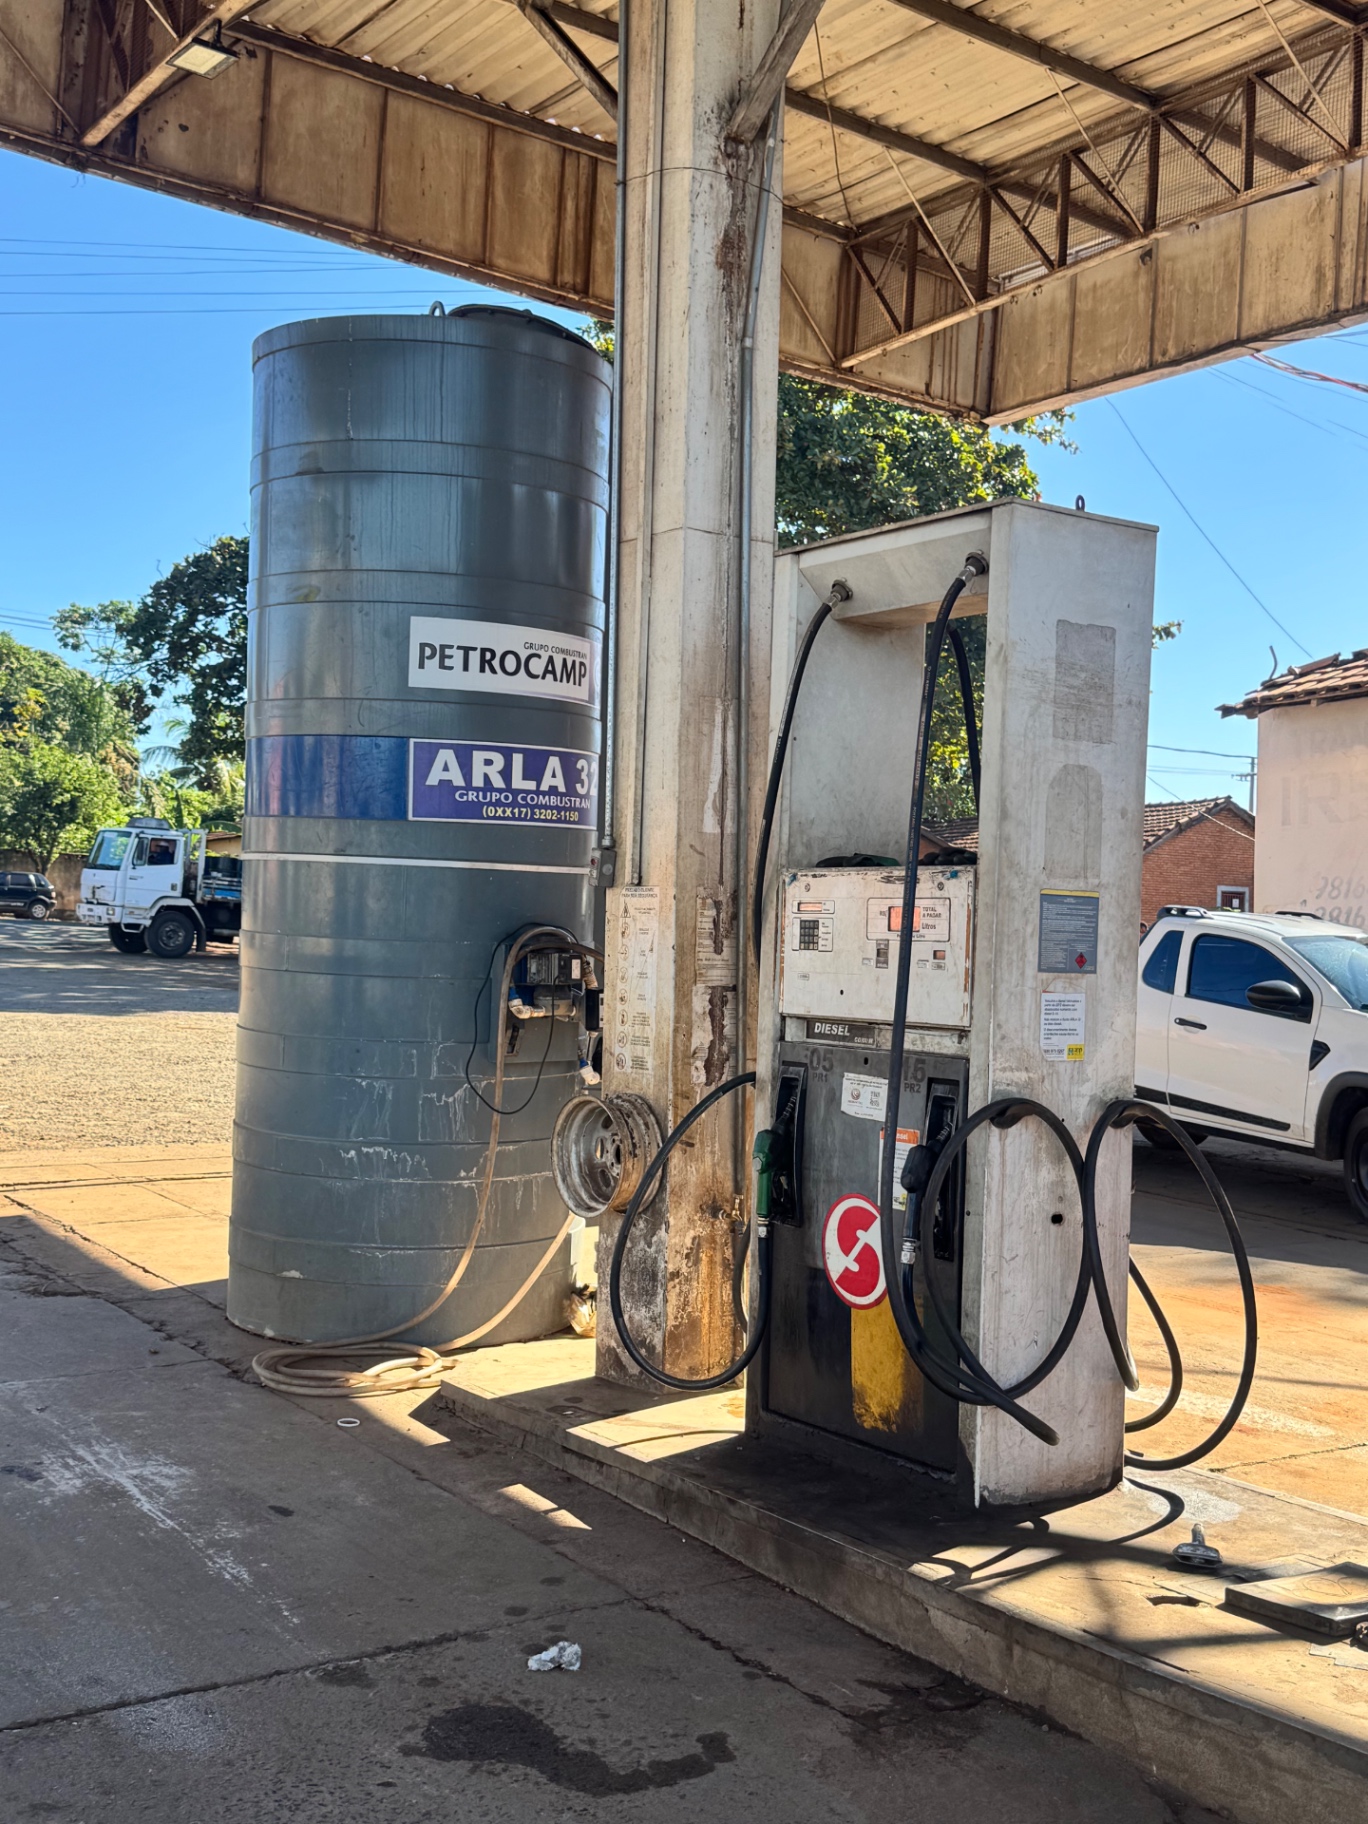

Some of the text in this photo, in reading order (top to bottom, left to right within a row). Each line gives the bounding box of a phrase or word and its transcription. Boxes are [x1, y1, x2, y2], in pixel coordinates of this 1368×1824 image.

[523, 641, 588, 660] GRUPO COMBUSTRAN
[418, 642, 587, 687] PETROCAMP
[425, 748, 567, 793] ARLA
[455, 790, 591, 810] GRUPO COMBUSTRAN
[482, 805, 579, 822] (0XX17) 3202-1150
[921, 922, 937, 930] Litros
[814, 1022, 850, 1036] DIESEL
[812, 1072, 828, 1082] PR1
[904, 1082, 922, 1094] PR2
